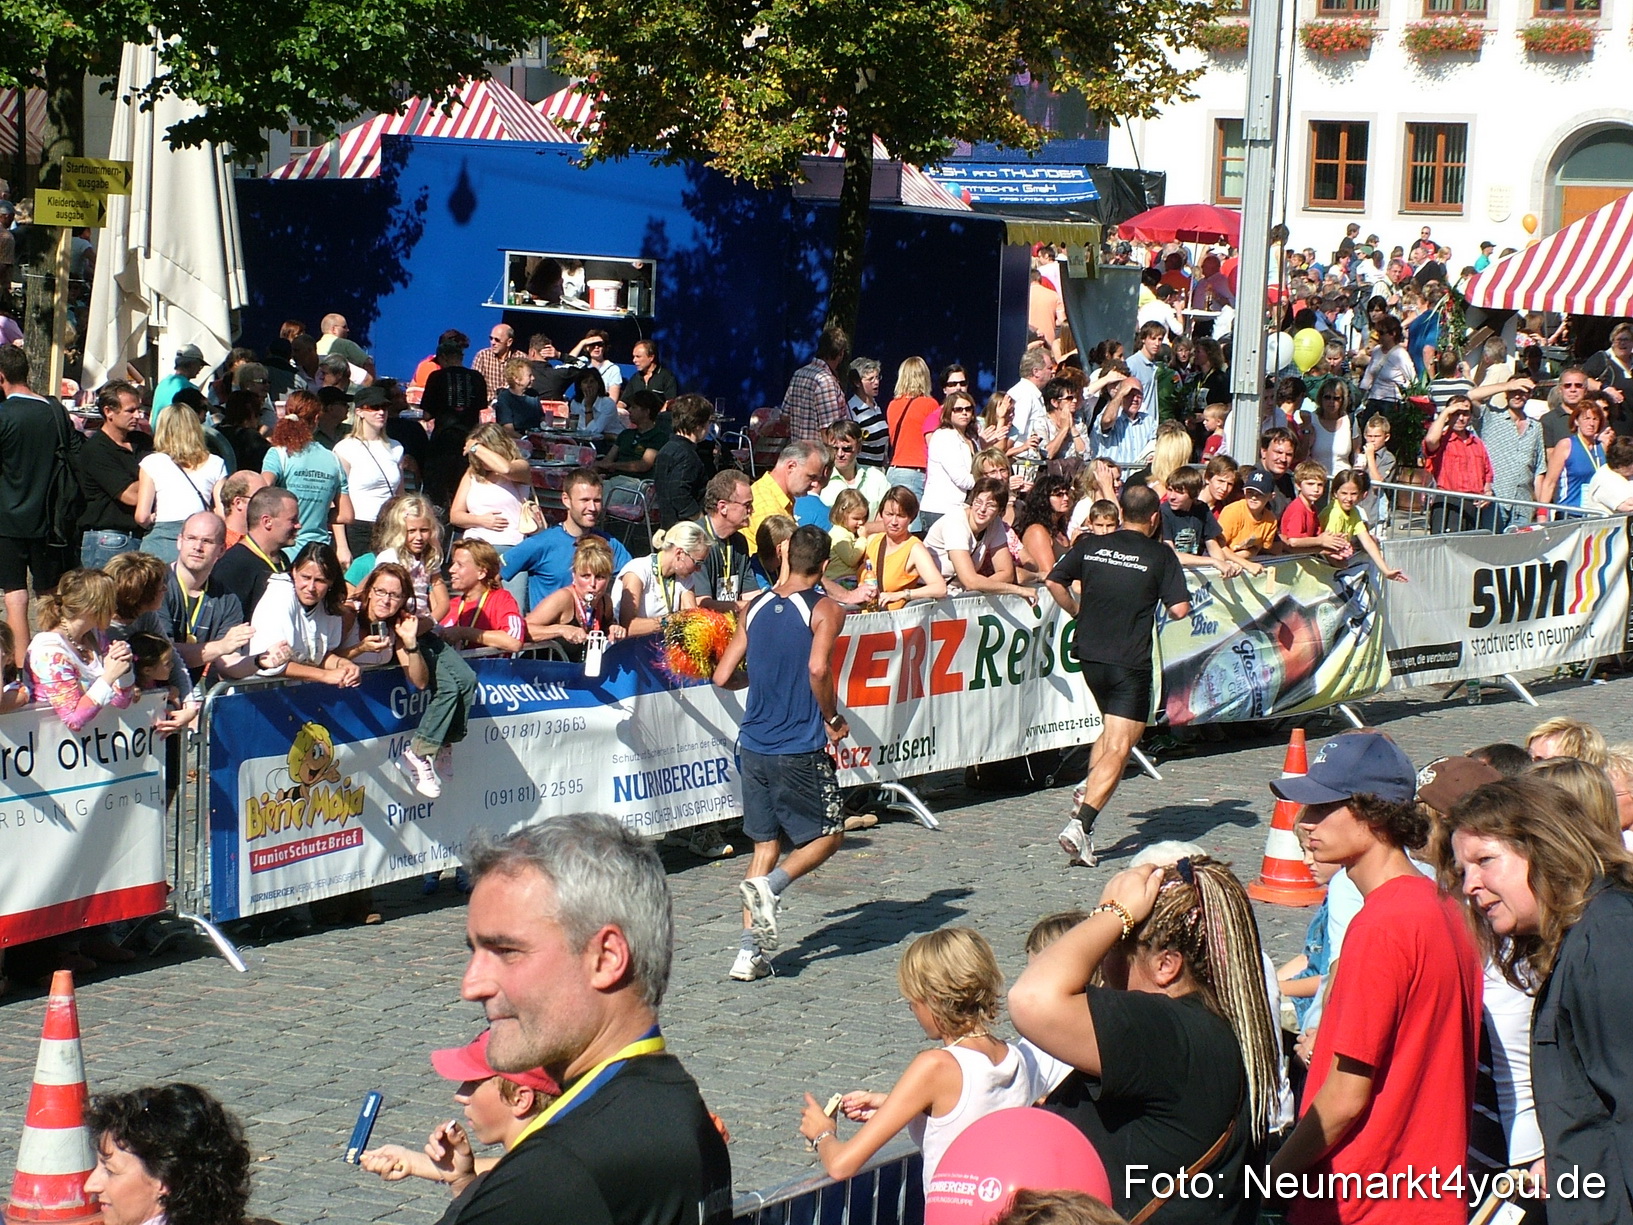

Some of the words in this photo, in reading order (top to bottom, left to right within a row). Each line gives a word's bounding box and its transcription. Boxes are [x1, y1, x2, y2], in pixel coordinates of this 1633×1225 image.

[66, 162, 122, 176] Startnummern-
[999, 168, 1084, 178] THUNDER
[77, 178, 109, 190] ausgabe
[47, 196, 95, 210] Kleiderbeutel-
[55, 210, 85, 222] ausgabe
[1108, 558, 1122, 566] Team
[1113, 551, 1140, 562] Bayern
[1468, 560, 1568, 629] swn
[1190, 612, 1219, 637] Bier
[1471, 628, 1534, 657] stadtwerke
[832, 619, 968, 708] ERZ
[58, 726, 157, 770] ortner
[612, 750, 640, 764] Schutz
[677, 741, 699, 753] Zeichen
[700, 739, 710, 749] der
[711, 737, 727, 748] Burg
[877, 735, 937, 766] reisen!
[613, 757, 732, 803] NÜRNBERGER
[104, 785, 161, 810] GmbH
[245, 792, 305, 842] Biene
[308, 778, 366, 828] Maja
[388, 801, 434, 825] Pirner
[388, 849, 428, 871] Unterer
[431, 841, 464, 861] Markt
